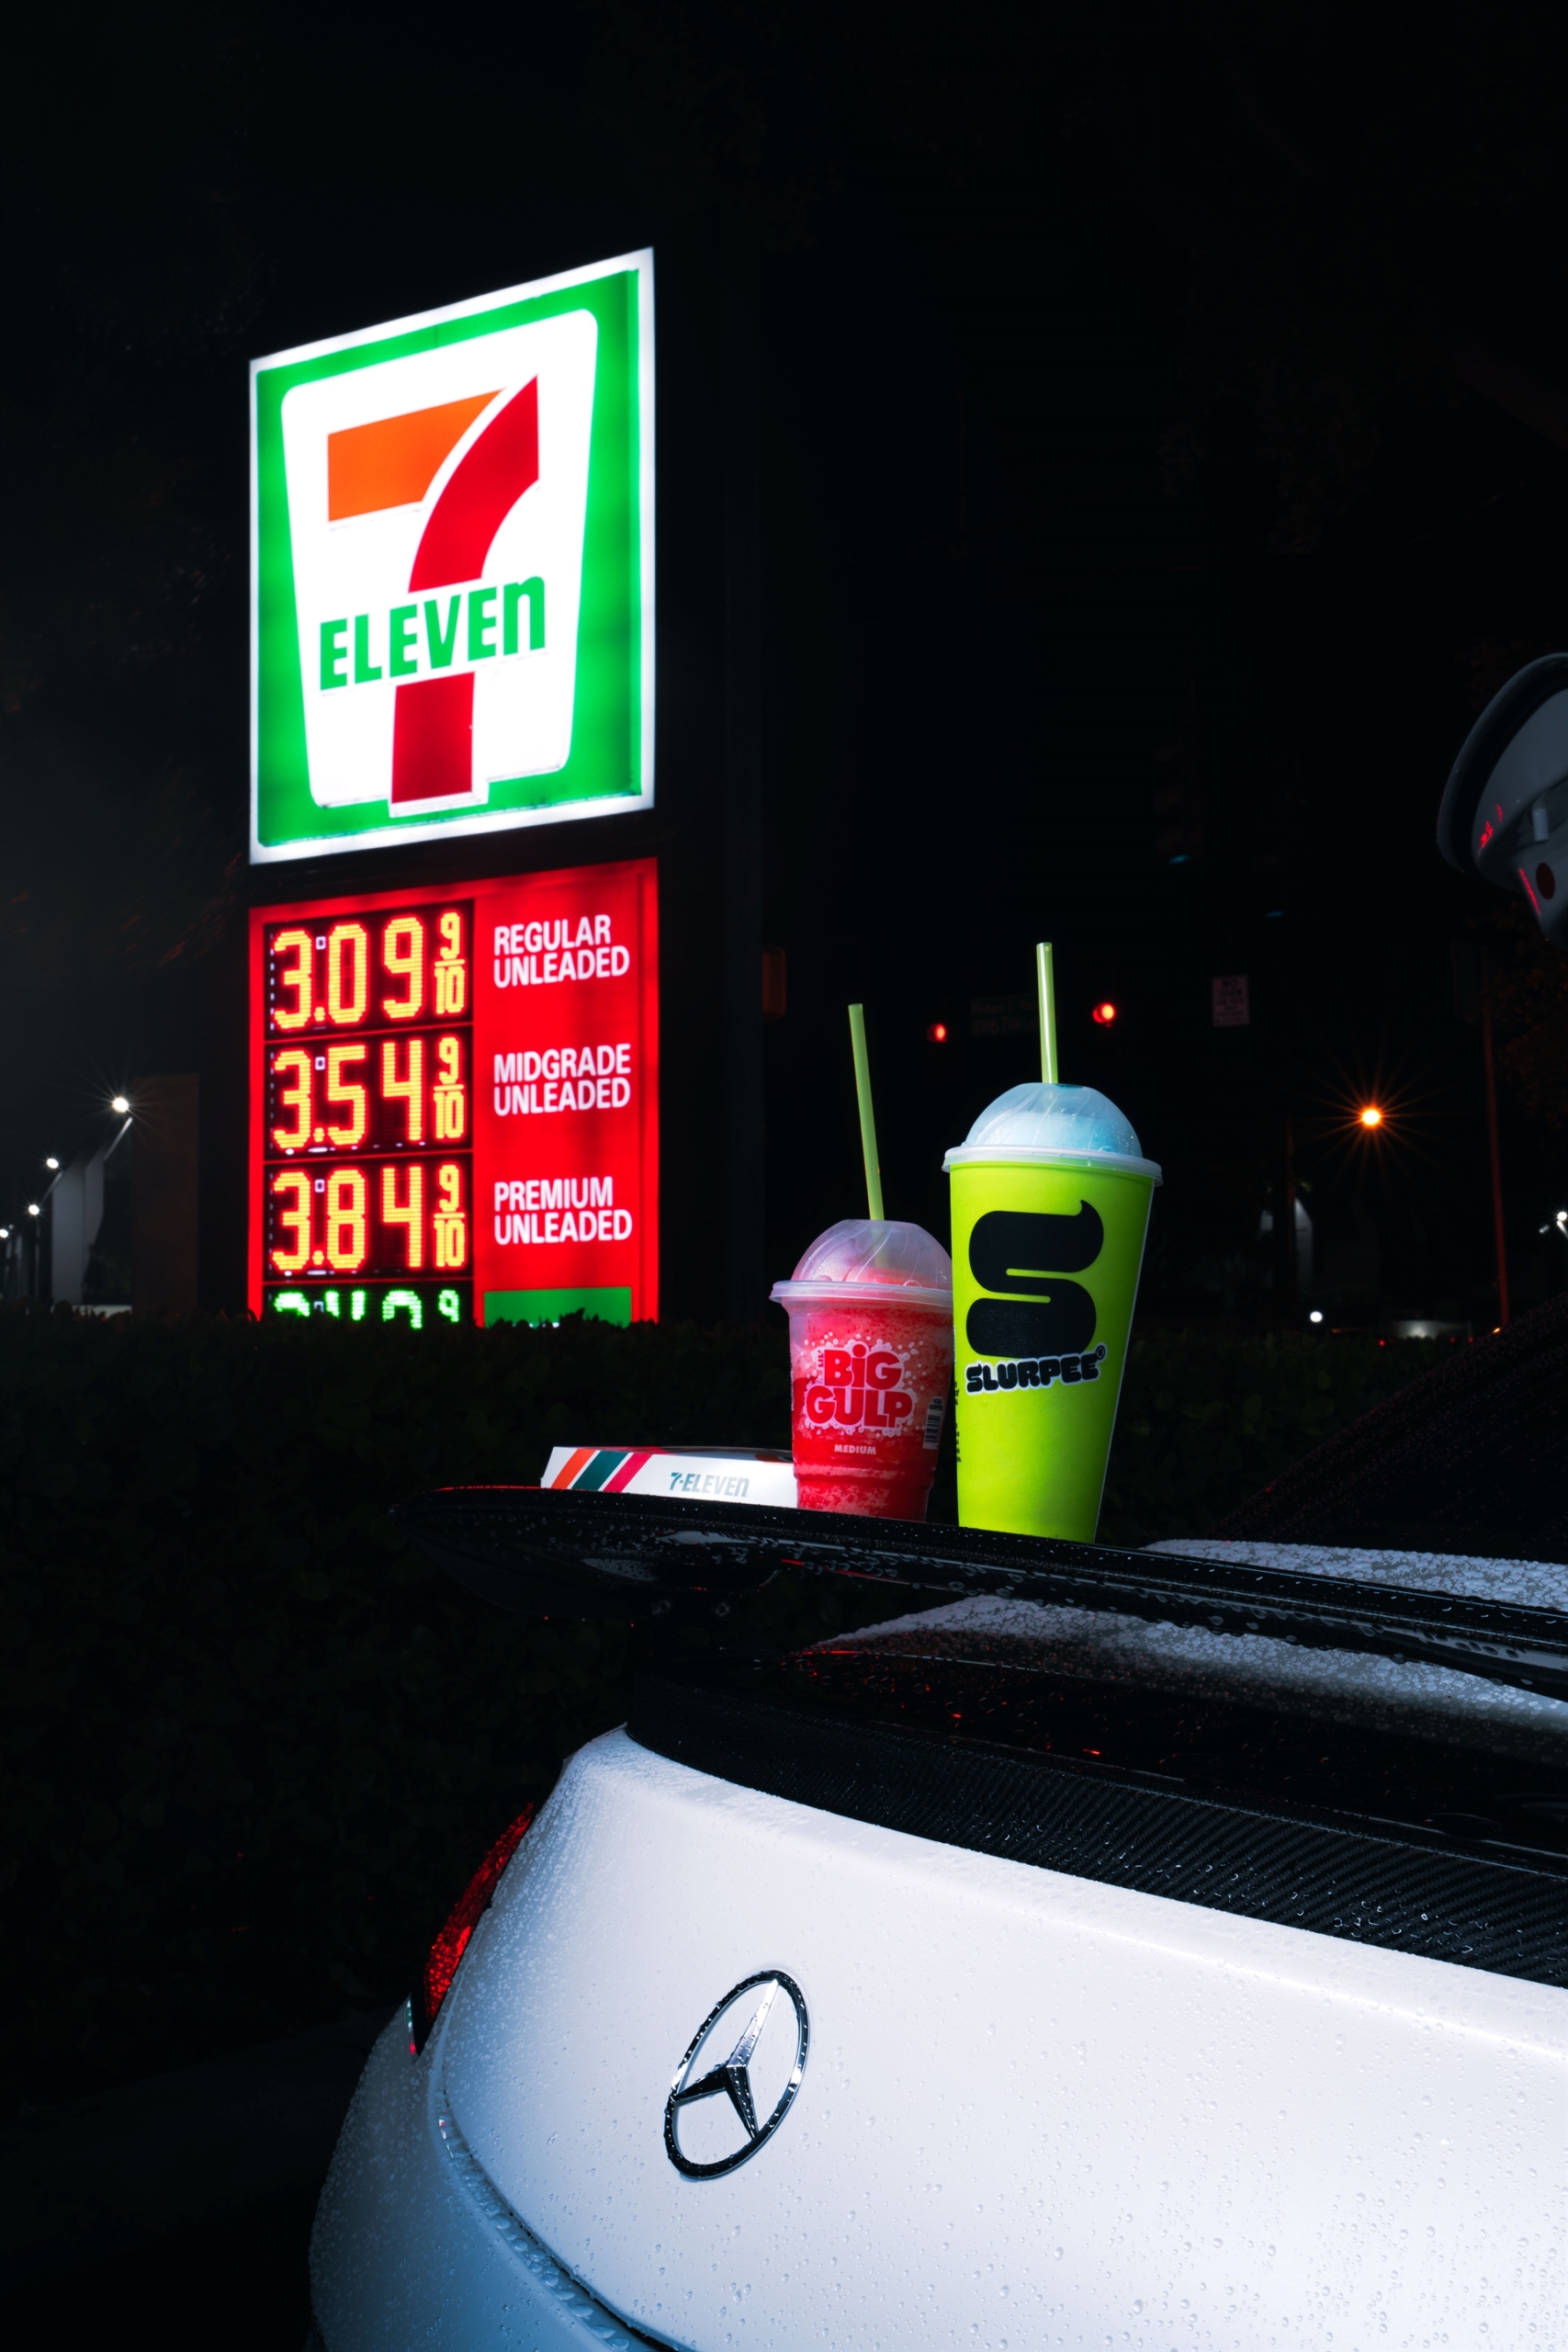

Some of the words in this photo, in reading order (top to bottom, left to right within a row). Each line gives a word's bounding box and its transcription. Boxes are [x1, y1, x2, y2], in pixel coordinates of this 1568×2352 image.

[327, 373, 539, 804] 7
[494, 914, 611, 956] REGULAR
[274, 917, 423, 1029] 3.09
[494, 945, 629, 989] UNLEADED
[494, 1043, 631, 1083] MIDGRADE
[274, 1040, 423, 1148] 3.54
[494, 1077, 630, 1116] UNLEADED
[494, 1176, 613, 1212] PREMIUM
[273, 1166, 423, 1271] 3.84
[494, 1210, 632, 1245] UNLEADED
[806, 1385, 913, 1429] GULP
[834, 1443, 876, 1455] MEDIUM
